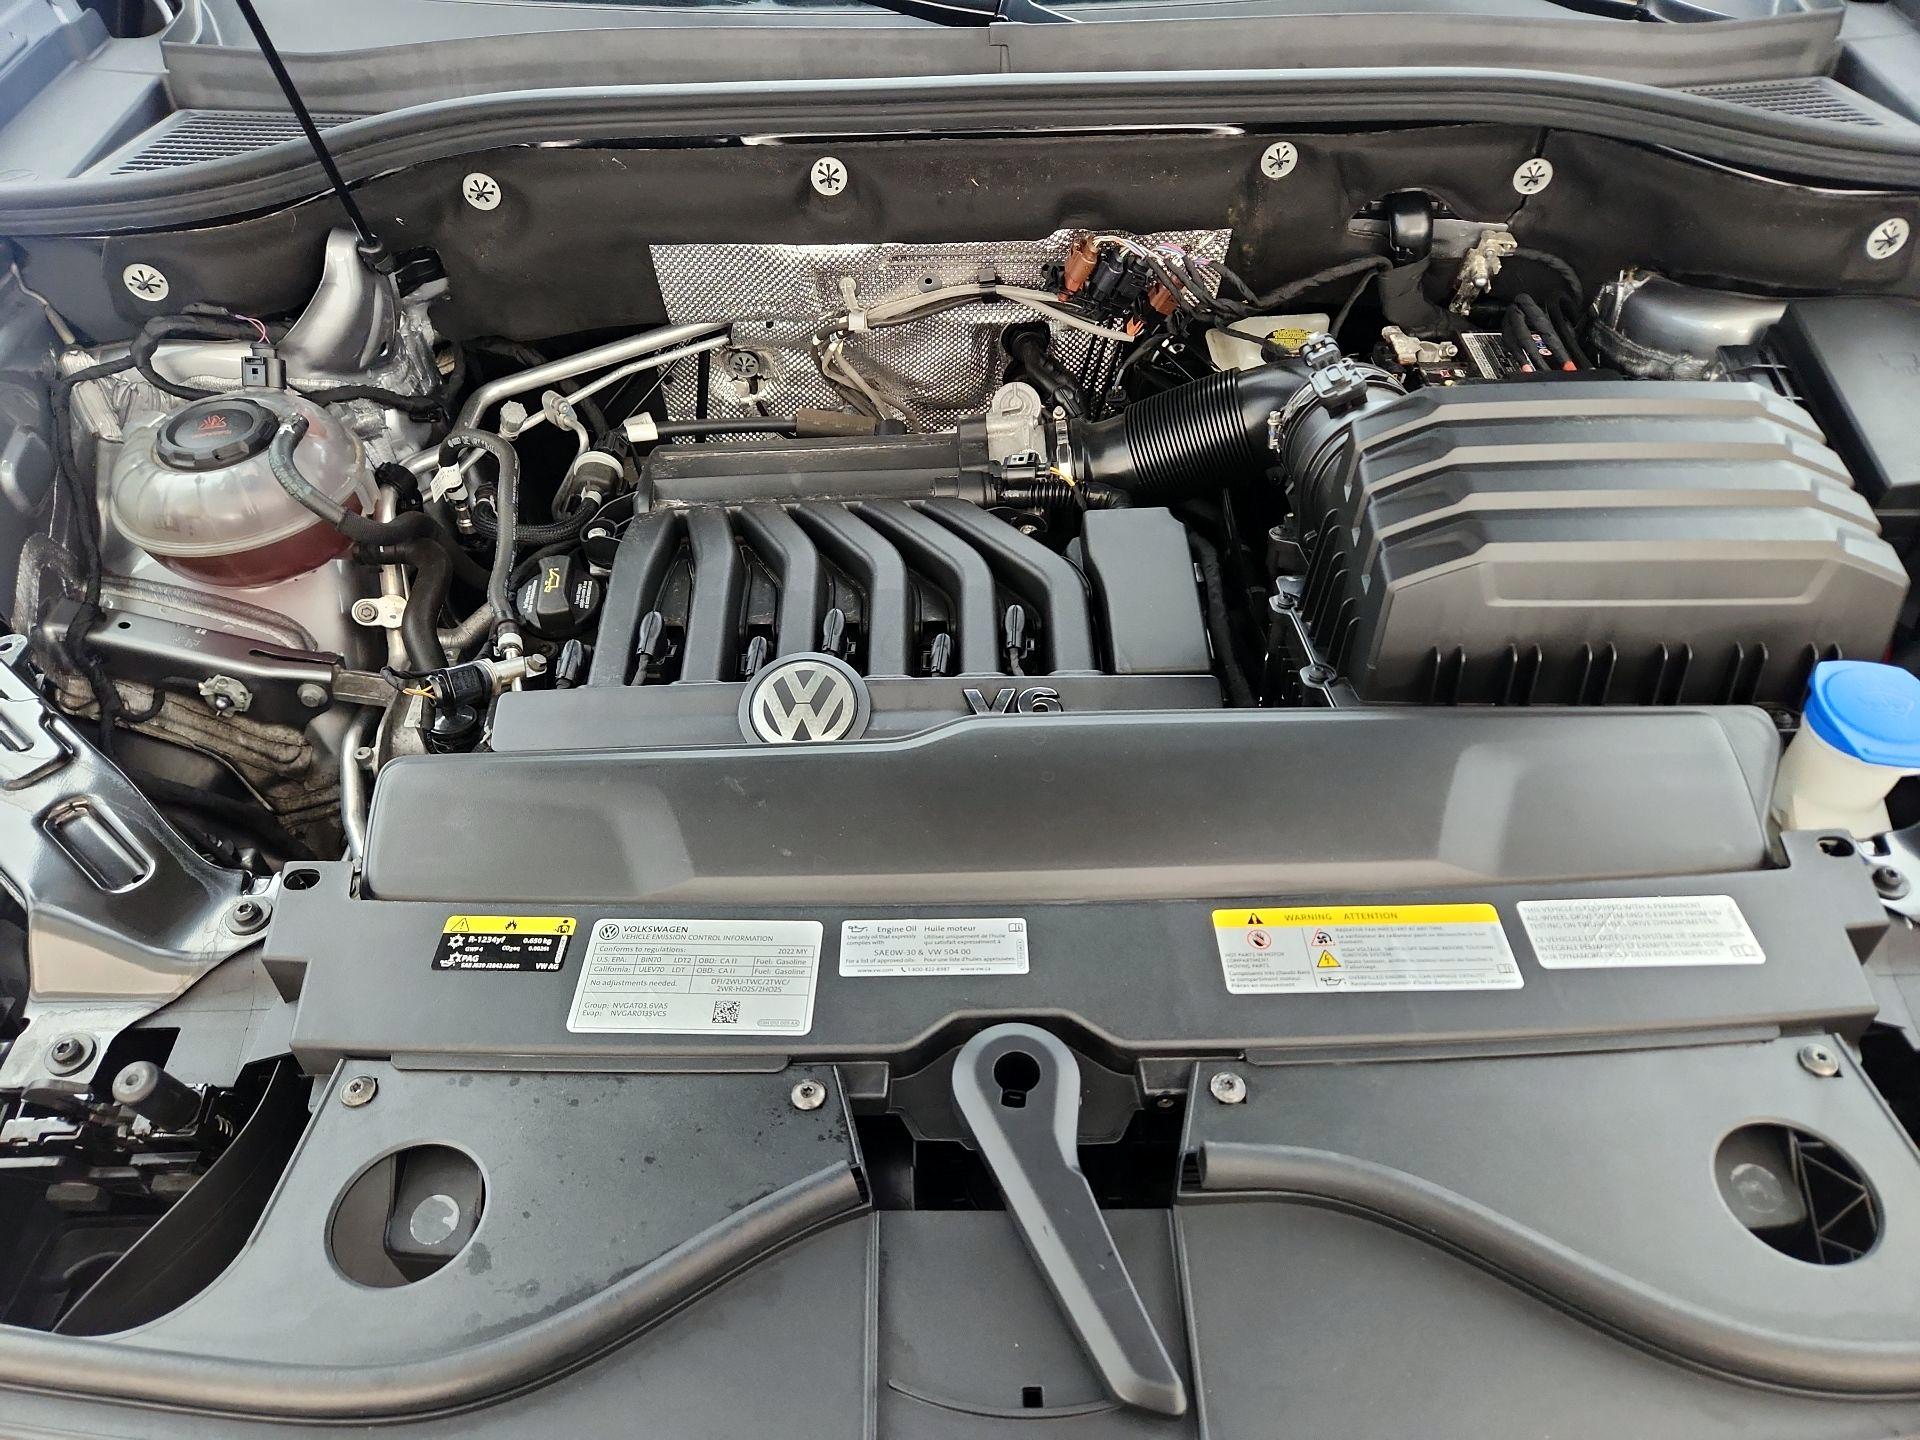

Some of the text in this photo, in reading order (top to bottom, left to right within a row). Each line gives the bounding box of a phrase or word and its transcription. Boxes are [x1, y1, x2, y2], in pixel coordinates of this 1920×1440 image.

[1284, 912, 1398, 920] WARNING ATTENTION
[468, 936, 506, 945] R-1234yf
[644, 946, 687, 955] regulations:
[602, 980, 647, 988] adjustments
[584, 1002, 609, 1010] Group:
[582, 1010, 602, 1018] Evap:
